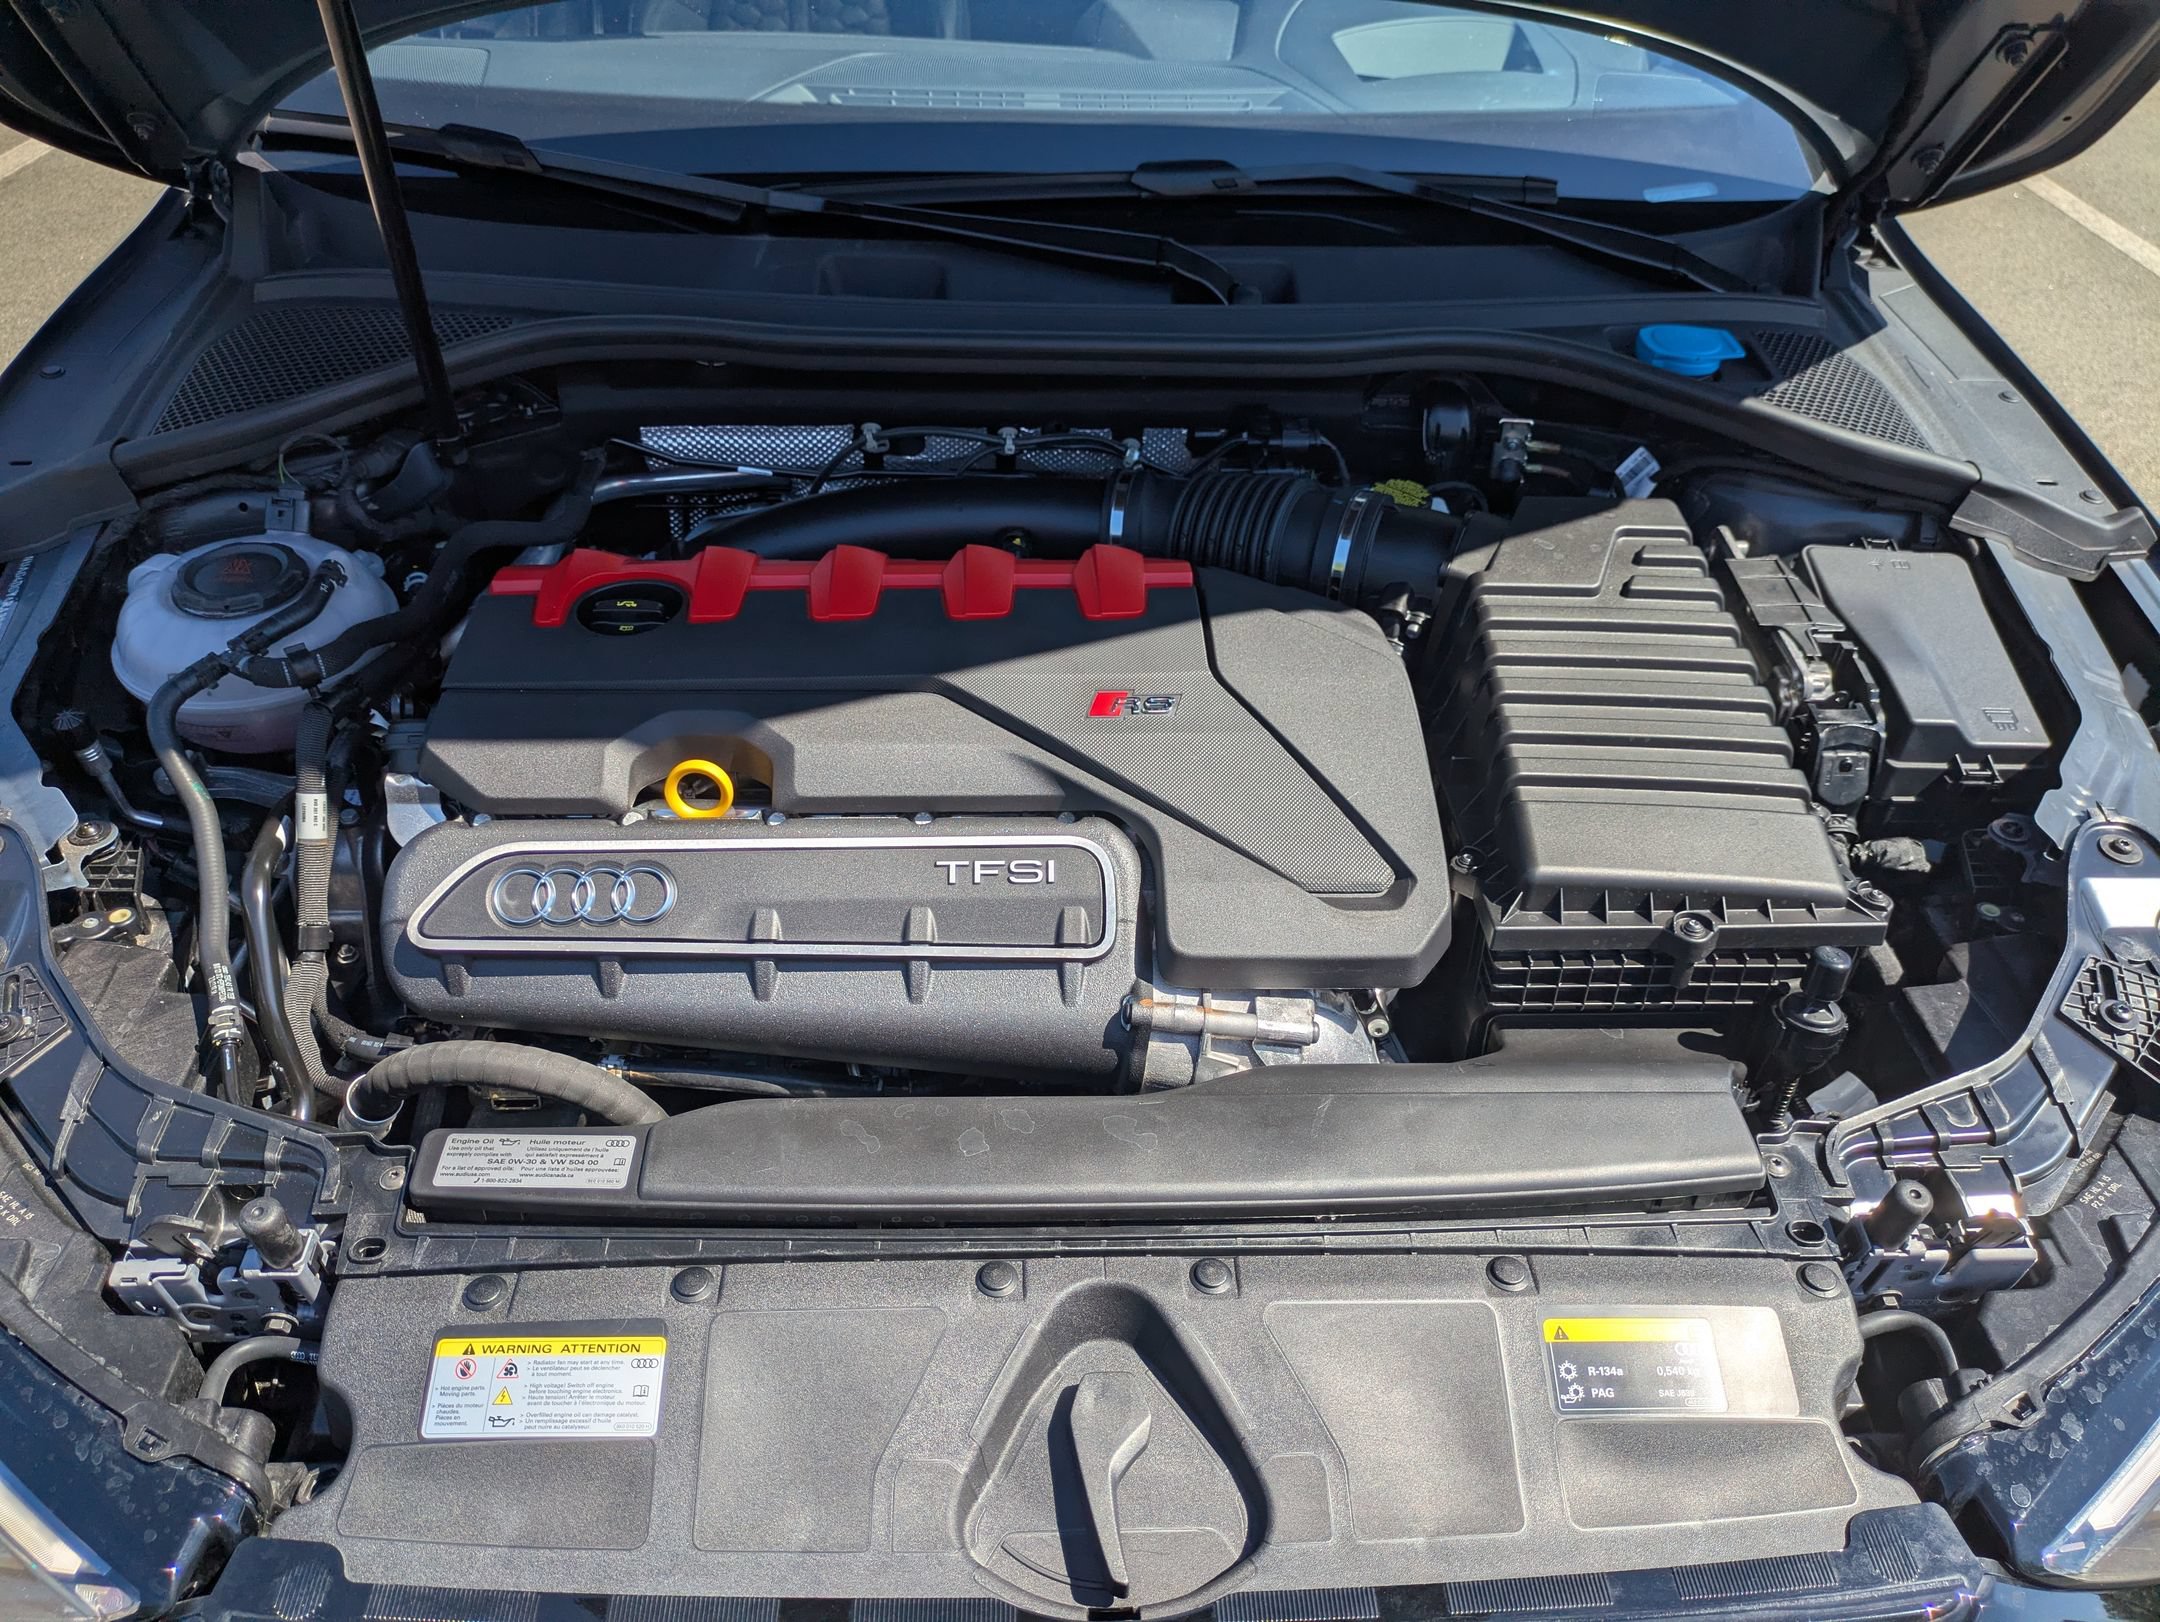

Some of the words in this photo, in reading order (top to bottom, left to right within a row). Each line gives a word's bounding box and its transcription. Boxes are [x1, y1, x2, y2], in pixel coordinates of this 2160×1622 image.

[934, 859, 1056, 885] TFSI
[2080, 1192, 2095, 1205] SAE
[482, 1344, 552, 1354] WARNING
[560, 1343, 641, 1353] ATTENTION
[1588, 1366, 1624, 1376] R-134a
[1656, 1366, 1685, 1377] 0,540
[1591, 1387, 1615, 1398] PAG
[1658, 1389, 1675, 1397] SAE
